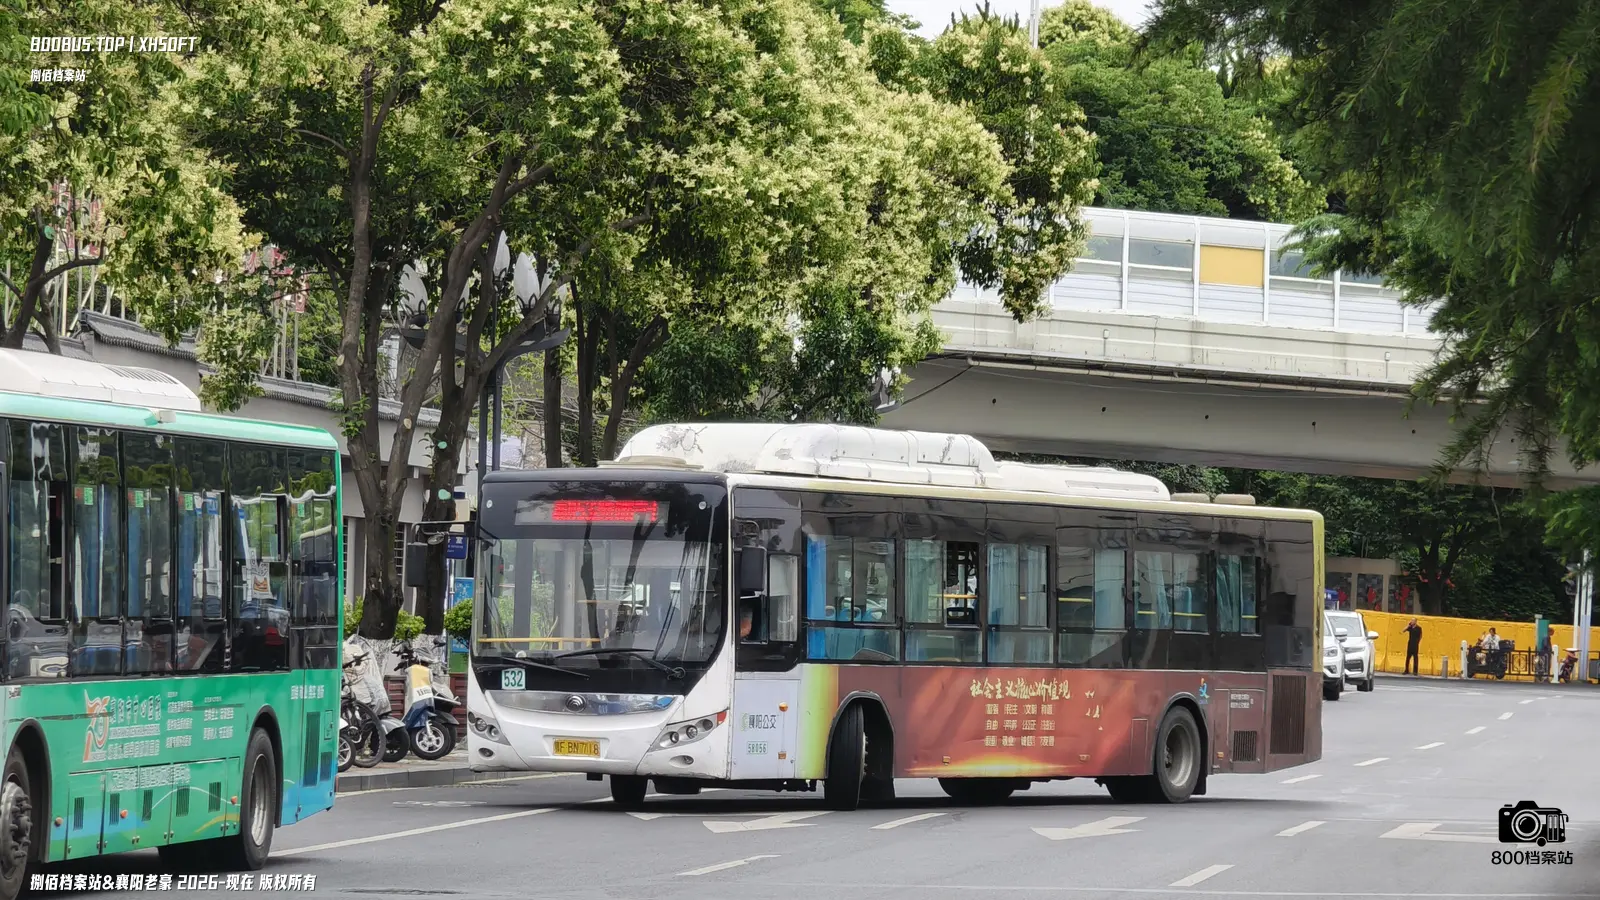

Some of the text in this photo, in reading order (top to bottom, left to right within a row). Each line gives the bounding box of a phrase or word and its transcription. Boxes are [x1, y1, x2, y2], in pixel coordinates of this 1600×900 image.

[503, 670, 524, 687] 532
[970, 677, 1071, 702] 社会主义核心价值观
